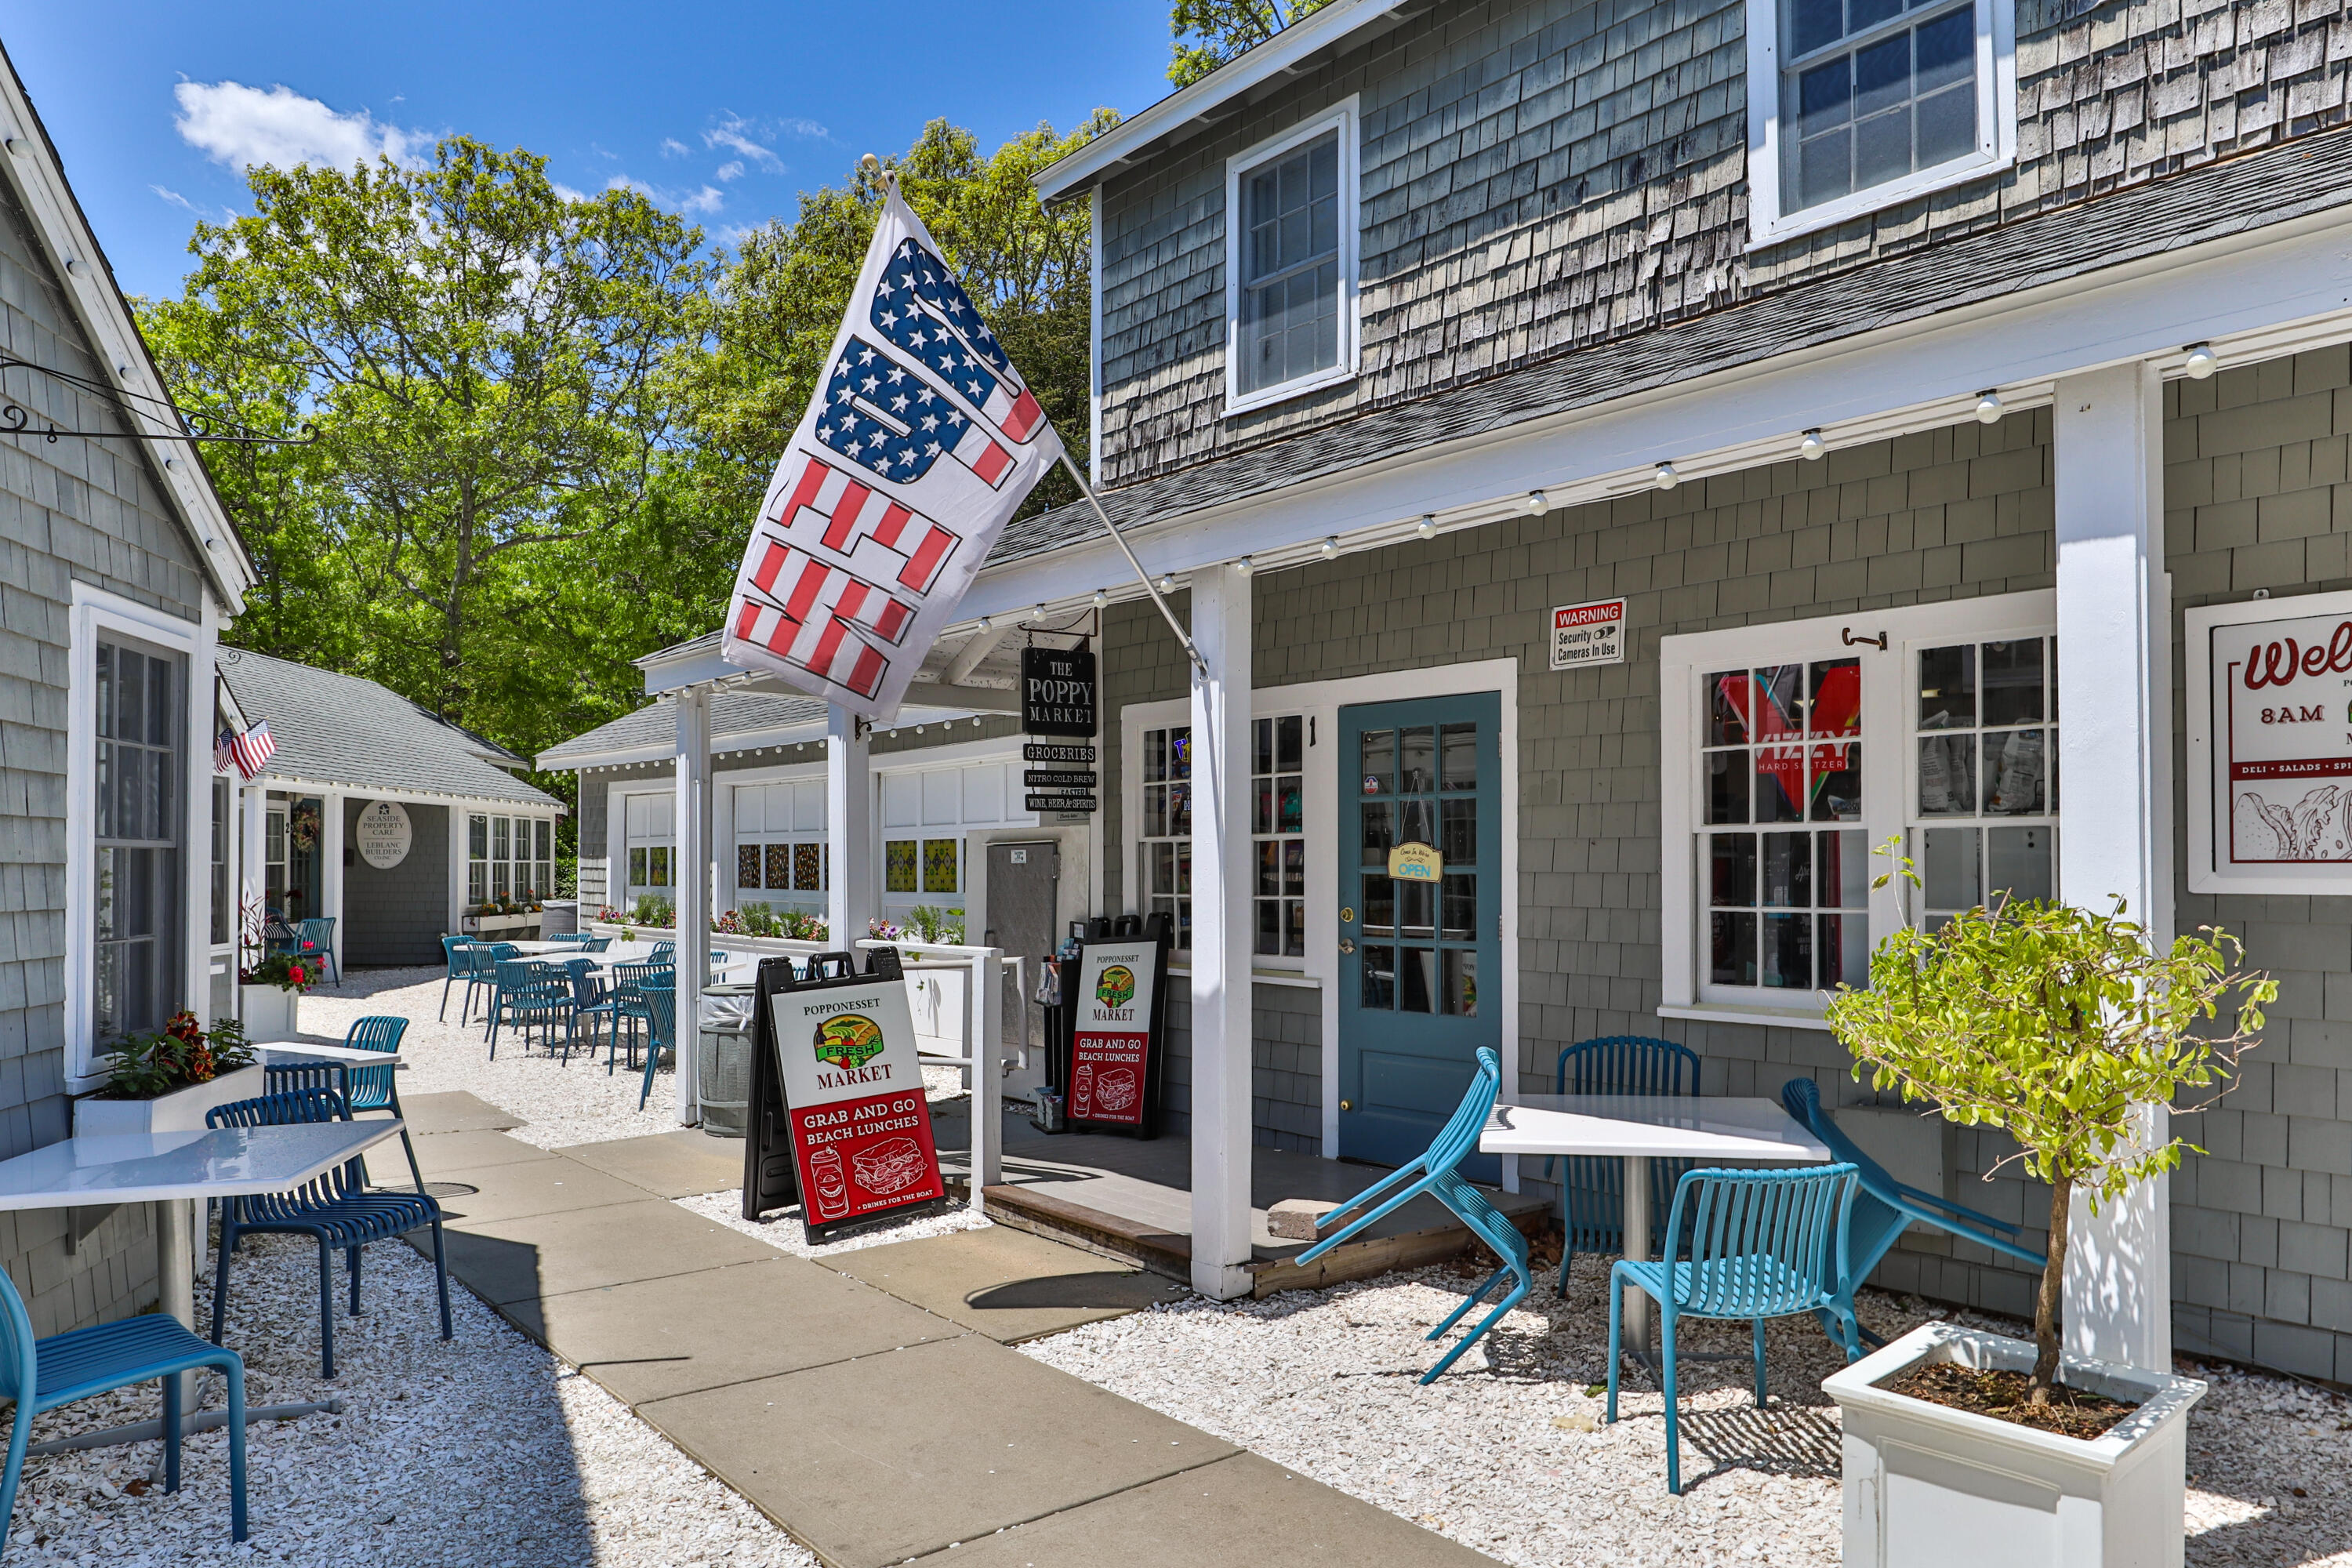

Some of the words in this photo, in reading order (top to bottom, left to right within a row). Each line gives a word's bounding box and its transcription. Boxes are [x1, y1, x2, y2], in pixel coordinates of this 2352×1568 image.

[1559, 605, 1619, 626] WARNING
[1559, 630, 1592, 645] Security
[1558, 648, 1590, 661] Cameras
[1592, 644, 1599, 656] In
[1602, 643, 1615, 655] Use
[2245, 621, 2352, 690] Wel
[1050, 662, 1073, 676] THE
[1027, 678, 1093, 705] POPPY
[1029, 706, 1091, 723] MARKET
[2261, 705, 2325, 725] 8AM
[1310, 716, 1316, 746] 1
[1027, 746, 1094, 760] GROCERIES
[1759, 762, 1788, 771] HARD
[1794, 760, 1843, 770] STZER
[2279, 764, 2321, 772] SALADS
[1029, 798, 1047, 809] WINE,
[1073, 799, 1095, 808] SPIRITS
[1399, 863, 1432, 877] OPEN
[1097, 955, 1139, 964] POPPONESSET
[1102, 989, 1128, 998] FRESH
[804, 998, 880, 1016] POPPONESSET
[1092, 1008, 1134, 1021] MARKET
[826, 1045, 875, 1056] FRESH
[1080, 1038, 1103, 1048] GRAB
[1105, 1039, 1126, 1049] AND
[1128, 1040, 1142, 1049] GO
[1078, 1052, 1103, 1061] BEACH
[1105, 1053, 1140, 1062] LUNCHES
[816, 1064, 892, 1090] MARKET
[804, 1110, 848, 1128] GRAB
[853, 1103, 888, 1120] AND
[892, 1099, 916, 1112] GO
[806, 1127, 854, 1145] BEACH
[856, 1116, 919, 1136] LUNCHES
[862, 1200, 887, 1210] DRINKS
[888, 1196, 902, 1205] FOR
[916, 1189, 933, 1198] BOAT
